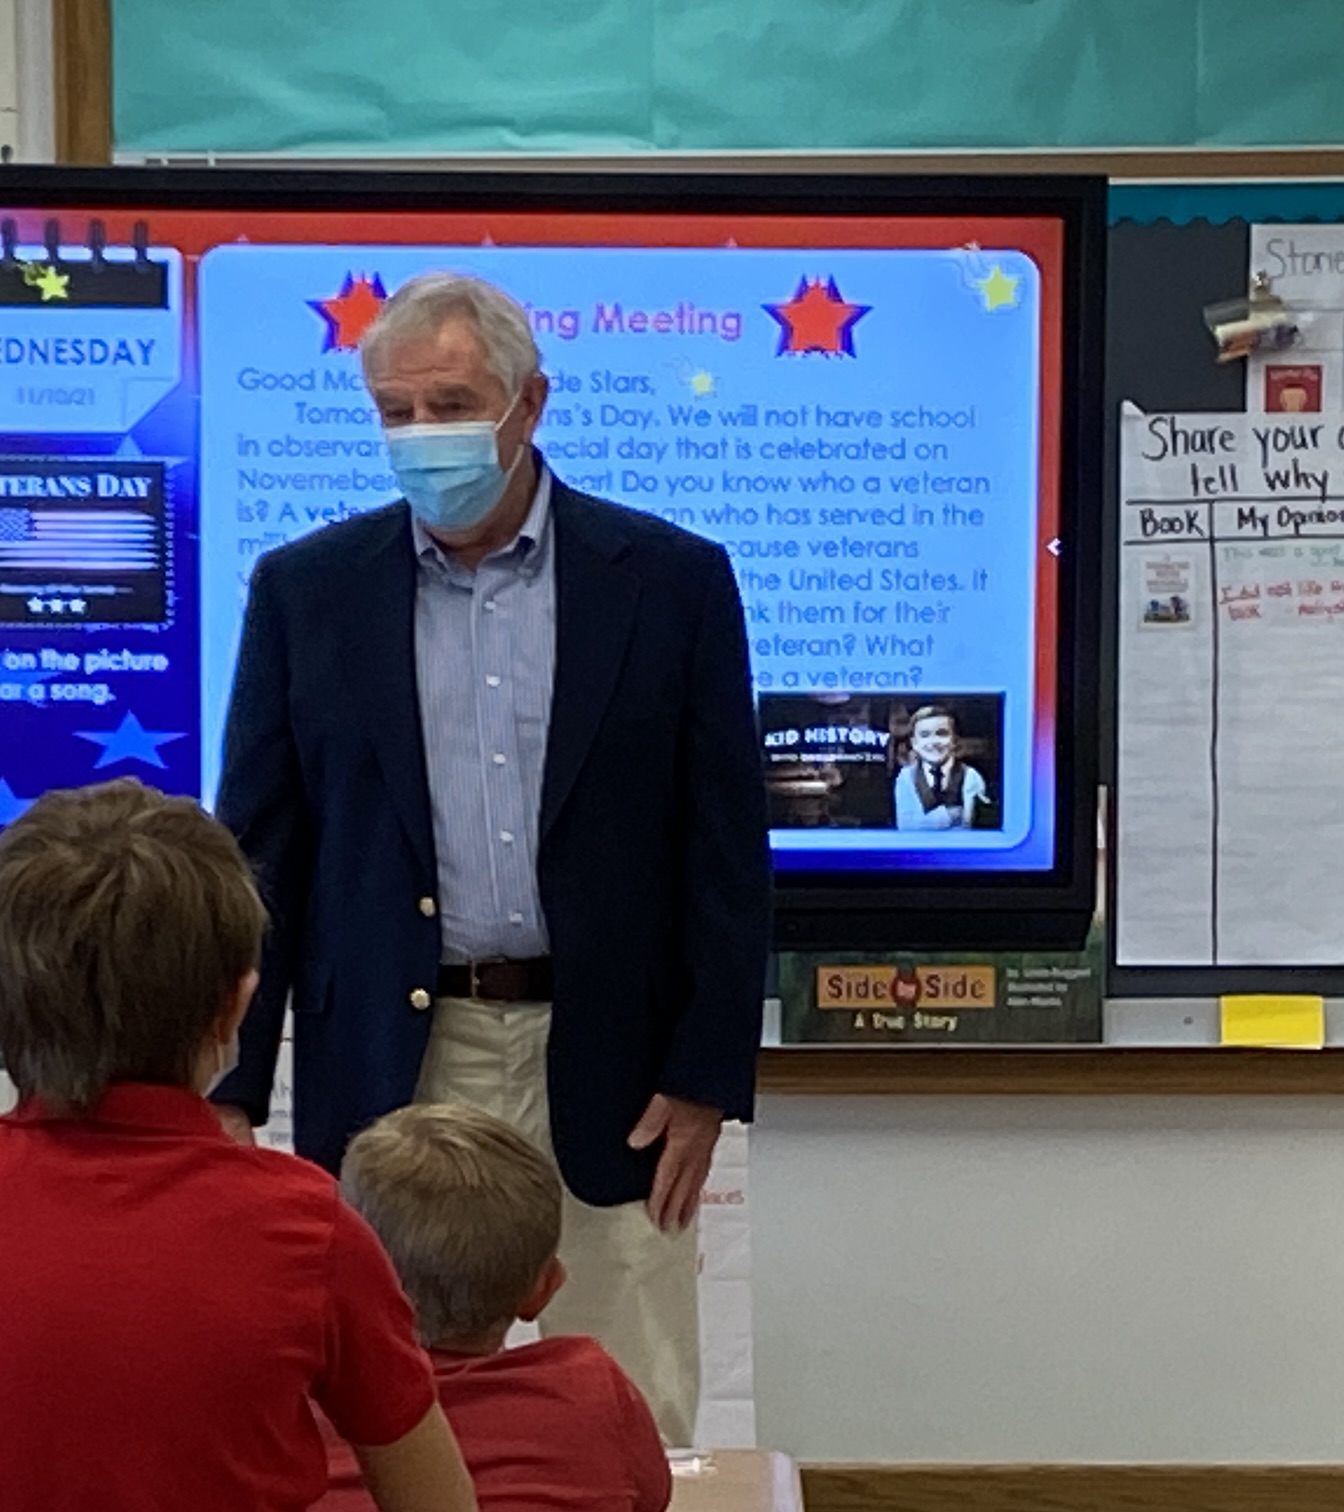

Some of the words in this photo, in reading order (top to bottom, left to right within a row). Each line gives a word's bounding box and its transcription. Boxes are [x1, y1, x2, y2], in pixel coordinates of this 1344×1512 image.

[592, 302, 743, 341] Meeting
[238, 367, 316, 391] Good
[590, 370, 656, 397] Stars,
[601, 404, 661, 431] Day.
[669, 405, 710, 427] We
[717, 402, 757, 427] will
[764, 404, 808, 427] not
[816, 403, 883, 427] have
[890, 403, 977, 428] school
[237, 433, 261, 457] in
[616, 436, 667, 464] day
[675, 437, 731, 460] that
[737, 437, 753, 460] is
[760, 436, 907, 460] celebrated
[914, 444, 949, 460] on
[1141, 415, 1237, 462] Share
[1252, 424, 1325, 469] your
[97, 473, 153, 497] DAY
[621, 471, 660, 493] Do
[665, 477, 714, 497] you
[721, 472, 790, 494] know
[798, 472, 854, 494] who
[862, 476, 881, 494] a
[889, 473, 991, 494] veteran
[1190, 462, 1240, 497] tell
[1263, 457, 1329, 503] why
[237, 499, 269, 523] is?
[278, 502, 299, 522] A
[703, 503, 758, 526] who
[766, 503, 811, 526] has
[819, 503, 905, 527] served
[912, 505, 935, 526] in
[942, 503, 984, 527] the
[1139, 508, 1204, 538] Book
[1237, 506, 1270, 537] My
[809, 537, 920, 559] veterans
[789, 568, 872, 591] United
[880, 568, 964, 592] States.
[973, 569, 989, 591] It
[778, 601, 845, 624] them
[853, 601, 888, 624] for
[895, 601, 950, 624] their
[865, 634, 936, 657] What
[2, 652, 37, 671] on
[40, 648, 80, 671] the
[84, 648, 170, 676] picture
[781, 671, 800, 688] a
[807, 666, 924, 689] veteran?
[27, 684, 46, 700] a
[50, 683, 117, 706] song.
[804, 726, 891, 748] HISTORY
[827, 974, 887, 1000] Side
[897, 982, 917, 998] by
[924, 974, 986, 1000] Side
[855, 1013, 865, 1029] A
[872, 1014, 905, 1030] True
[913, 1013, 958, 1031] Story
